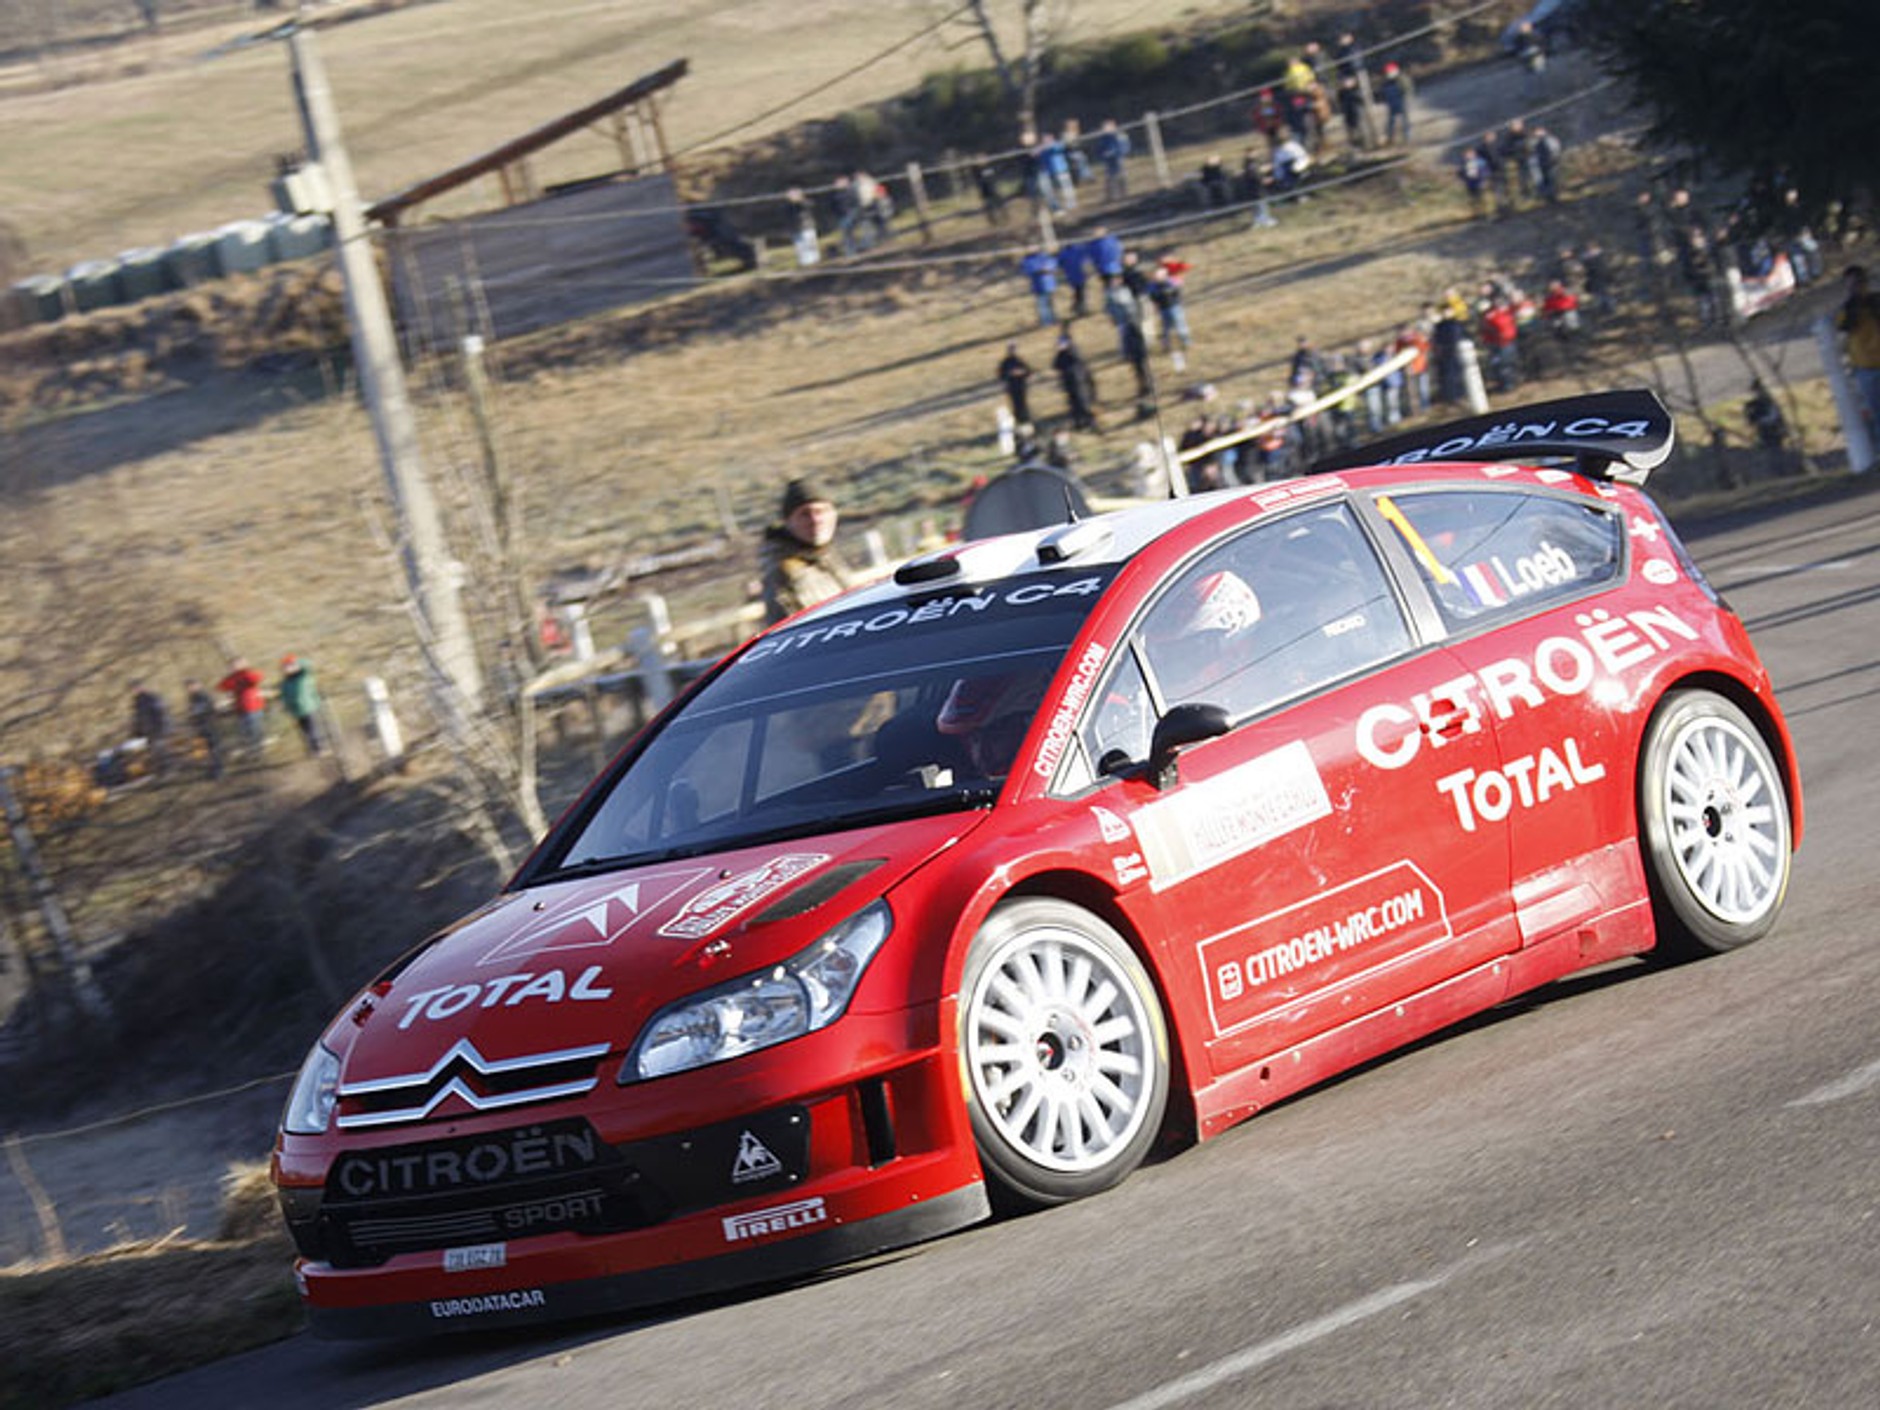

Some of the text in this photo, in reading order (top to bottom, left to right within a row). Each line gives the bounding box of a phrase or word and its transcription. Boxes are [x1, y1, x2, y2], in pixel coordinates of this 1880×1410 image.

[1563, 417, 1649, 437] C4
[1490, 541, 1576, 596] Loeb
[738, 577, 1102, 664] CITROËN C4
[1034, 641, 1106, 777] CITROEN-WRC.COM
[1355, 605, 1698, 770] CITROËN
[1437, 738, 1605, 831] TOTAL
[1246, 889, 1424, 986] CITROEN-WRC.COM
[398, 966, 612, 1029] TOTAL
[339, 1127, 597, 1195] CITROËN
[504, 1195, 607, 1229] SPORT
[722, 1197, 827, 1241] PIRELLI
[431, 1289, 546, 1318] EURODATACAR
